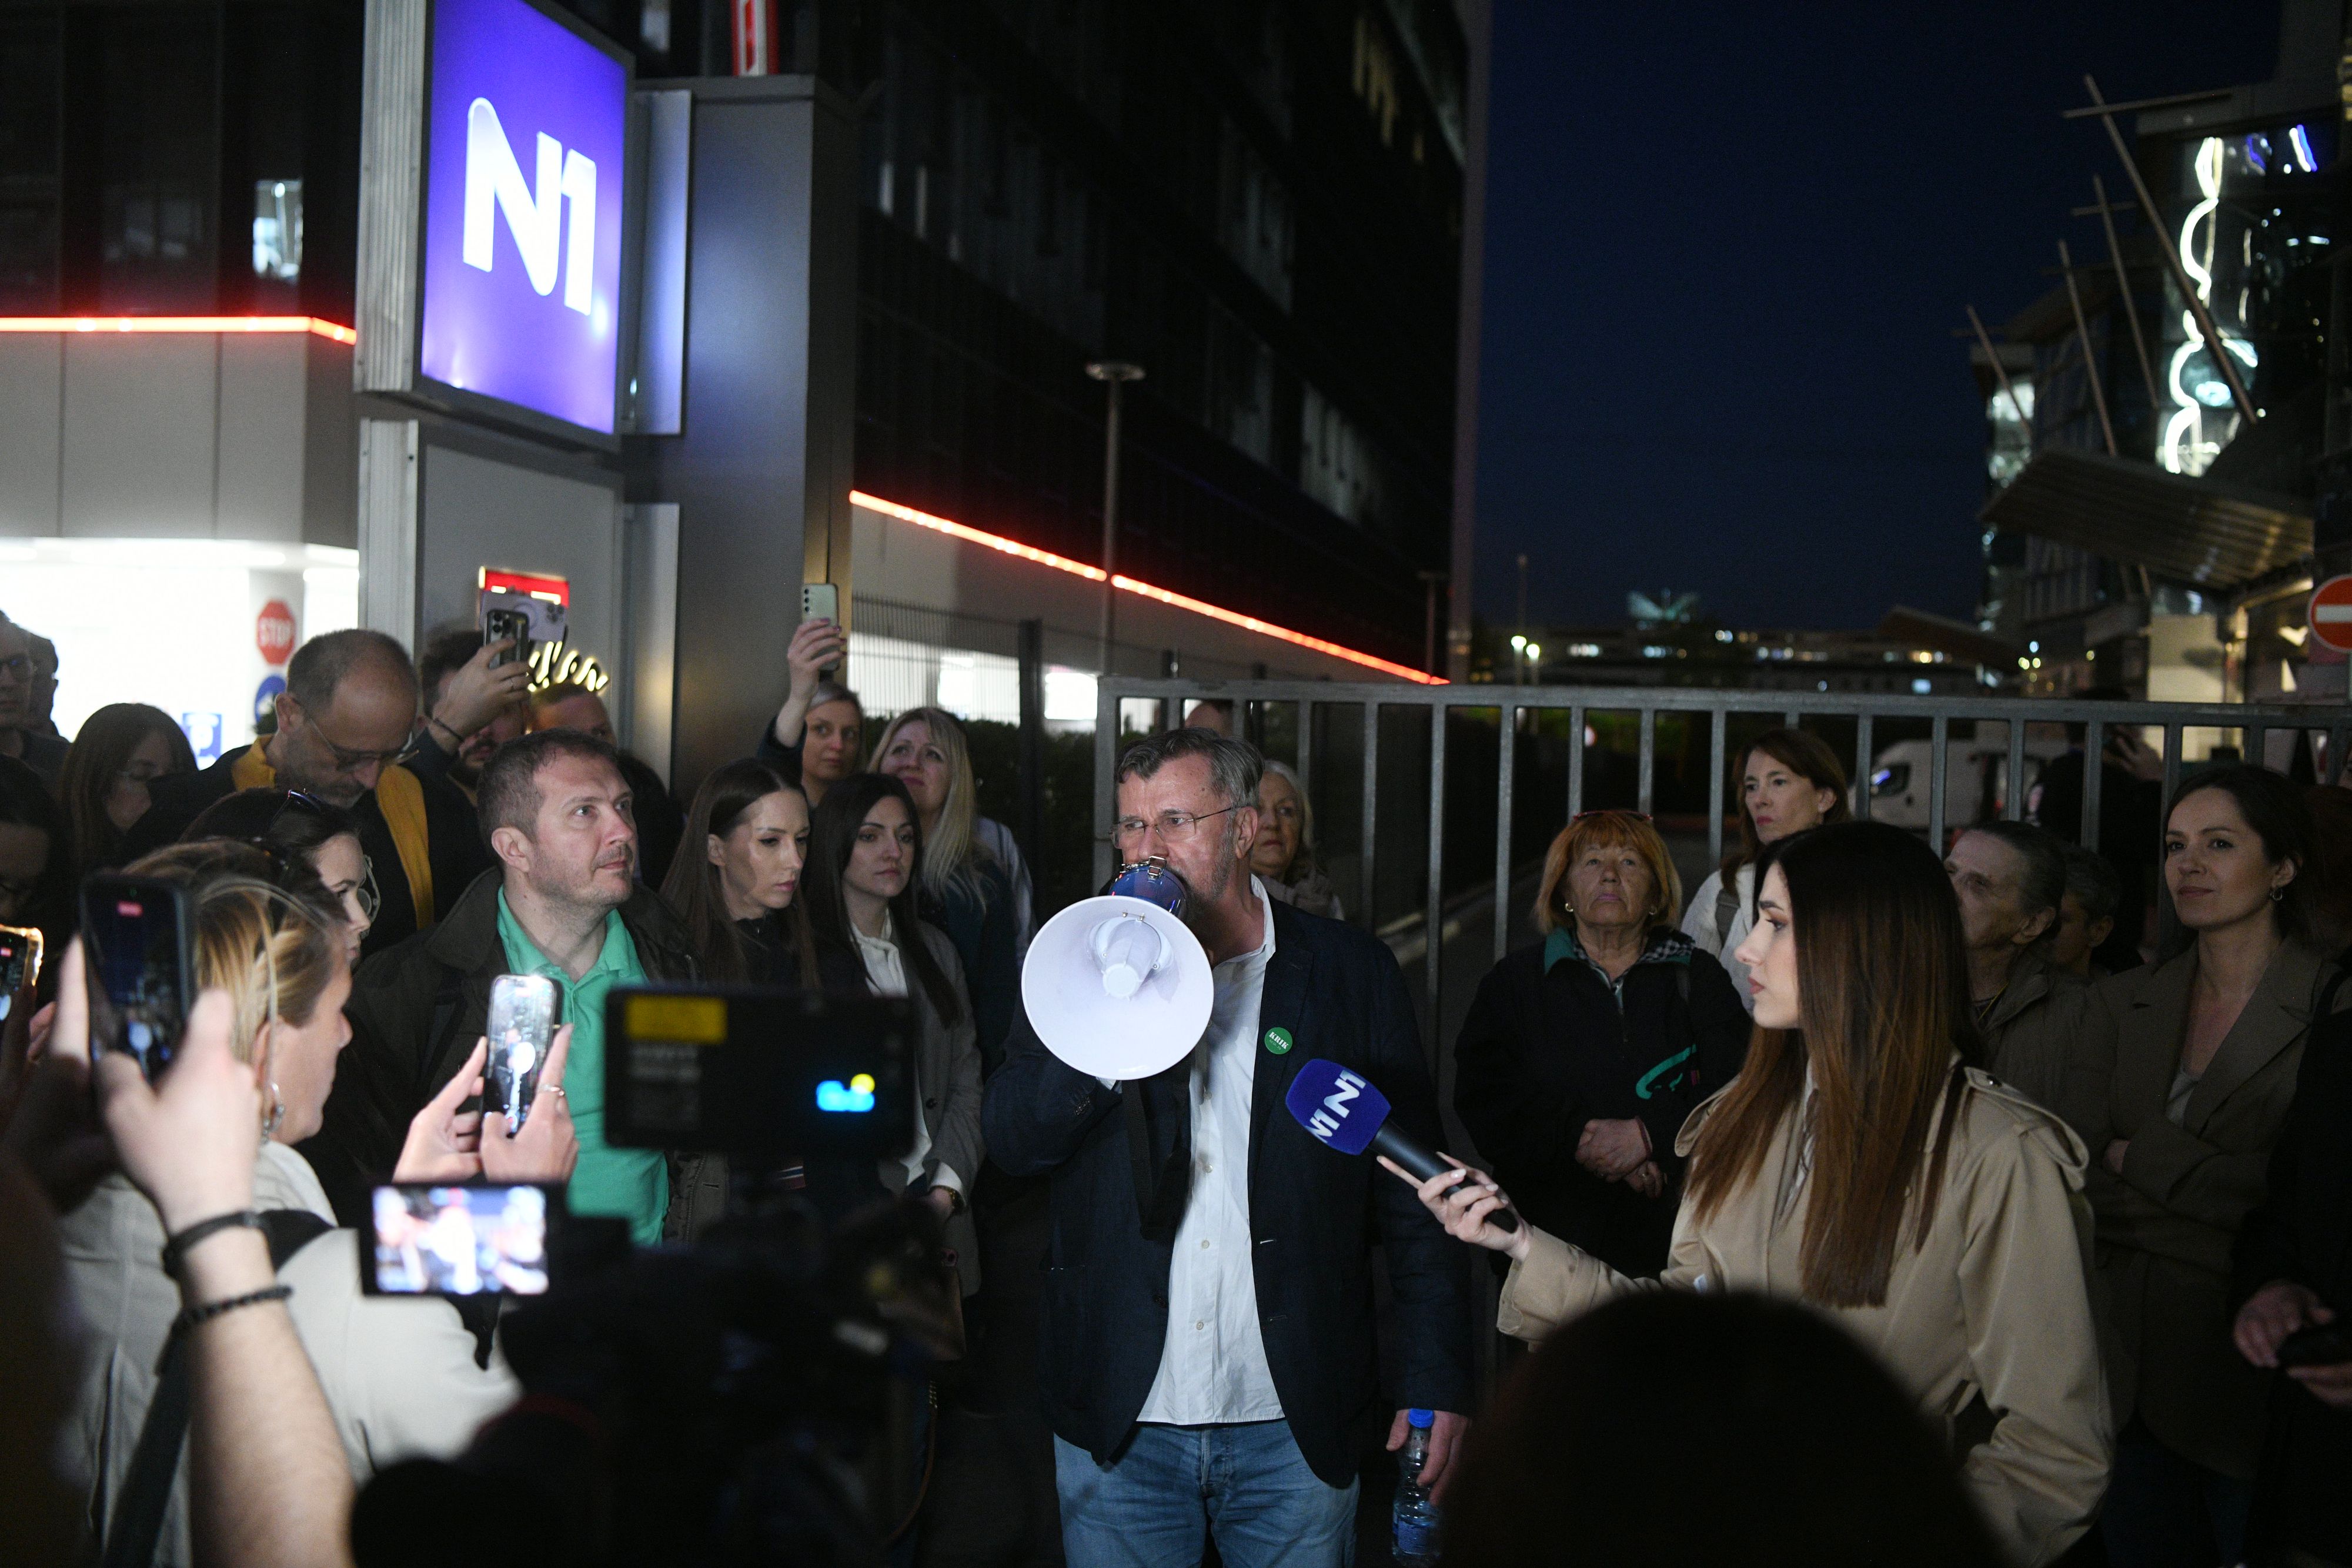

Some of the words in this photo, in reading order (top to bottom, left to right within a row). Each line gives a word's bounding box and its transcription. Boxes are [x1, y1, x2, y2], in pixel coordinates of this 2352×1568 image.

[463, 97, 597, 316] N1
[260, 617, 292, 647] STOP
[1269, 1032, 1289, 1049] KRIK
[1324, 1069, 1367, 1119] N1
[1305, 1108, 1341, 1144] N1
